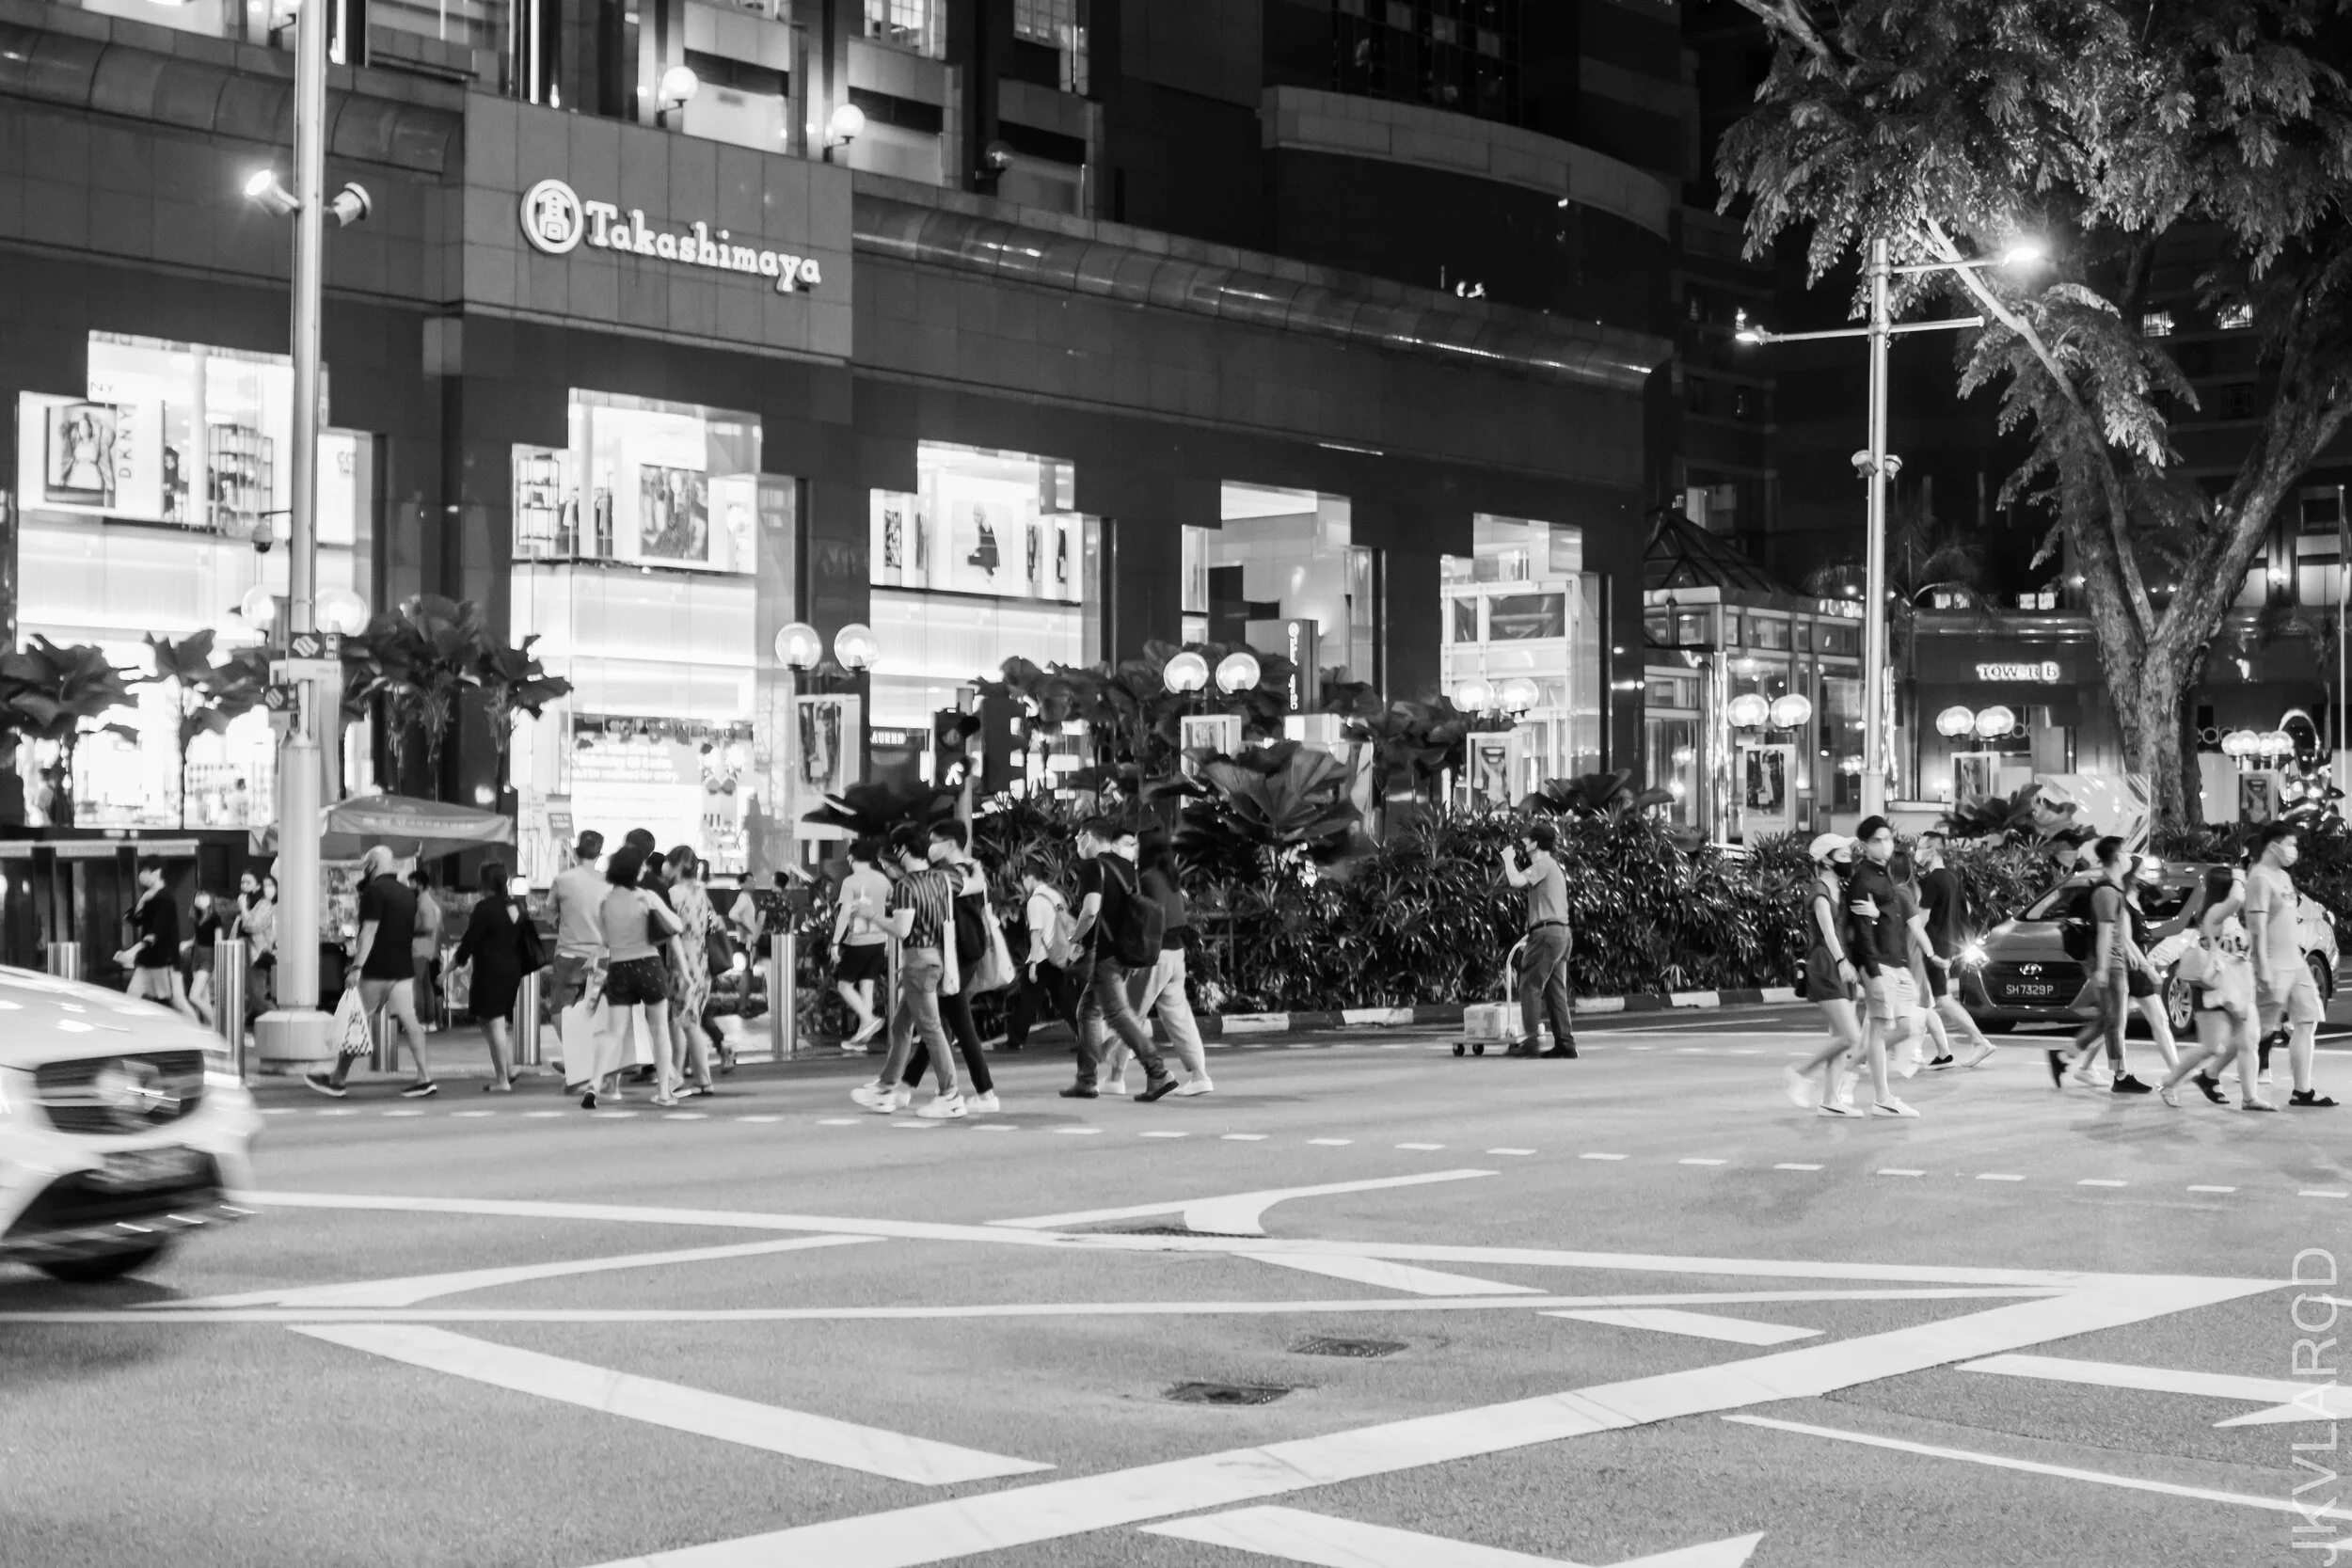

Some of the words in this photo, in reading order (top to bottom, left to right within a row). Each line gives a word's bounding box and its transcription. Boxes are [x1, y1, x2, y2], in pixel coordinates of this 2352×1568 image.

[586, 199, 821, 292] Takashimaya
[118, 407, 133, 478] DKNY
[2041, 661, 2059, 682] B
[2006, 984, 2019, 995] SH
[2046, 984, 2054, 995] P
